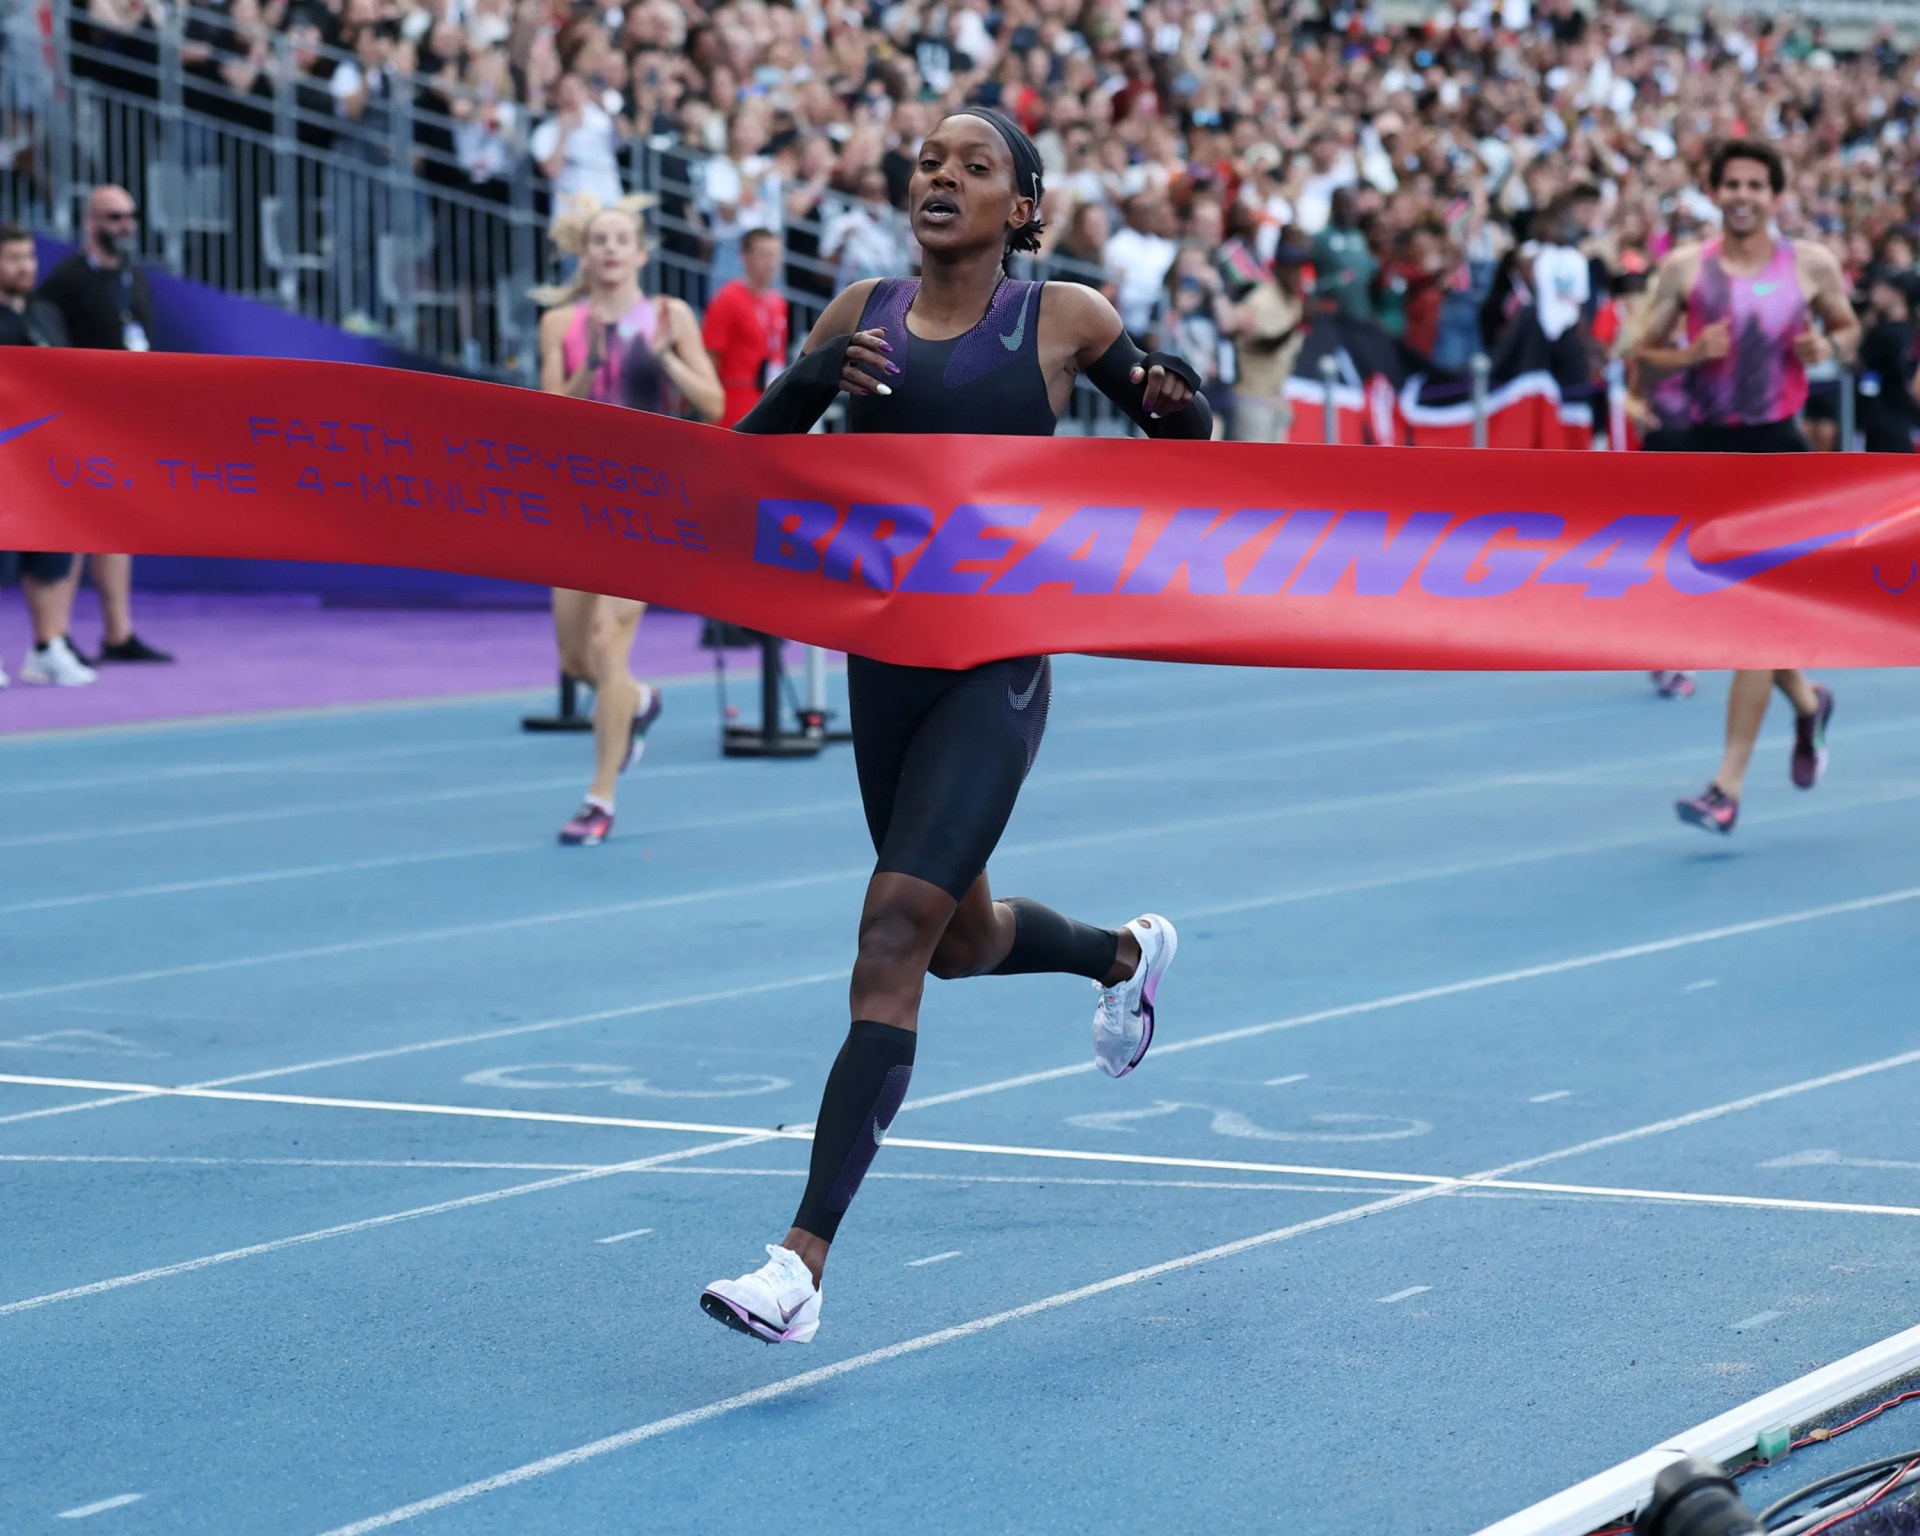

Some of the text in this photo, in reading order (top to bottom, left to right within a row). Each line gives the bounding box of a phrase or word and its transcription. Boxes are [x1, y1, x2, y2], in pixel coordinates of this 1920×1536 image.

[48, 456, 710, 552] VS. THE 4-MINUTE MILE
[249, 416, 690, 506] FAITH KIPYEGON
[753, 498, 1682, 599] BREAKING4
